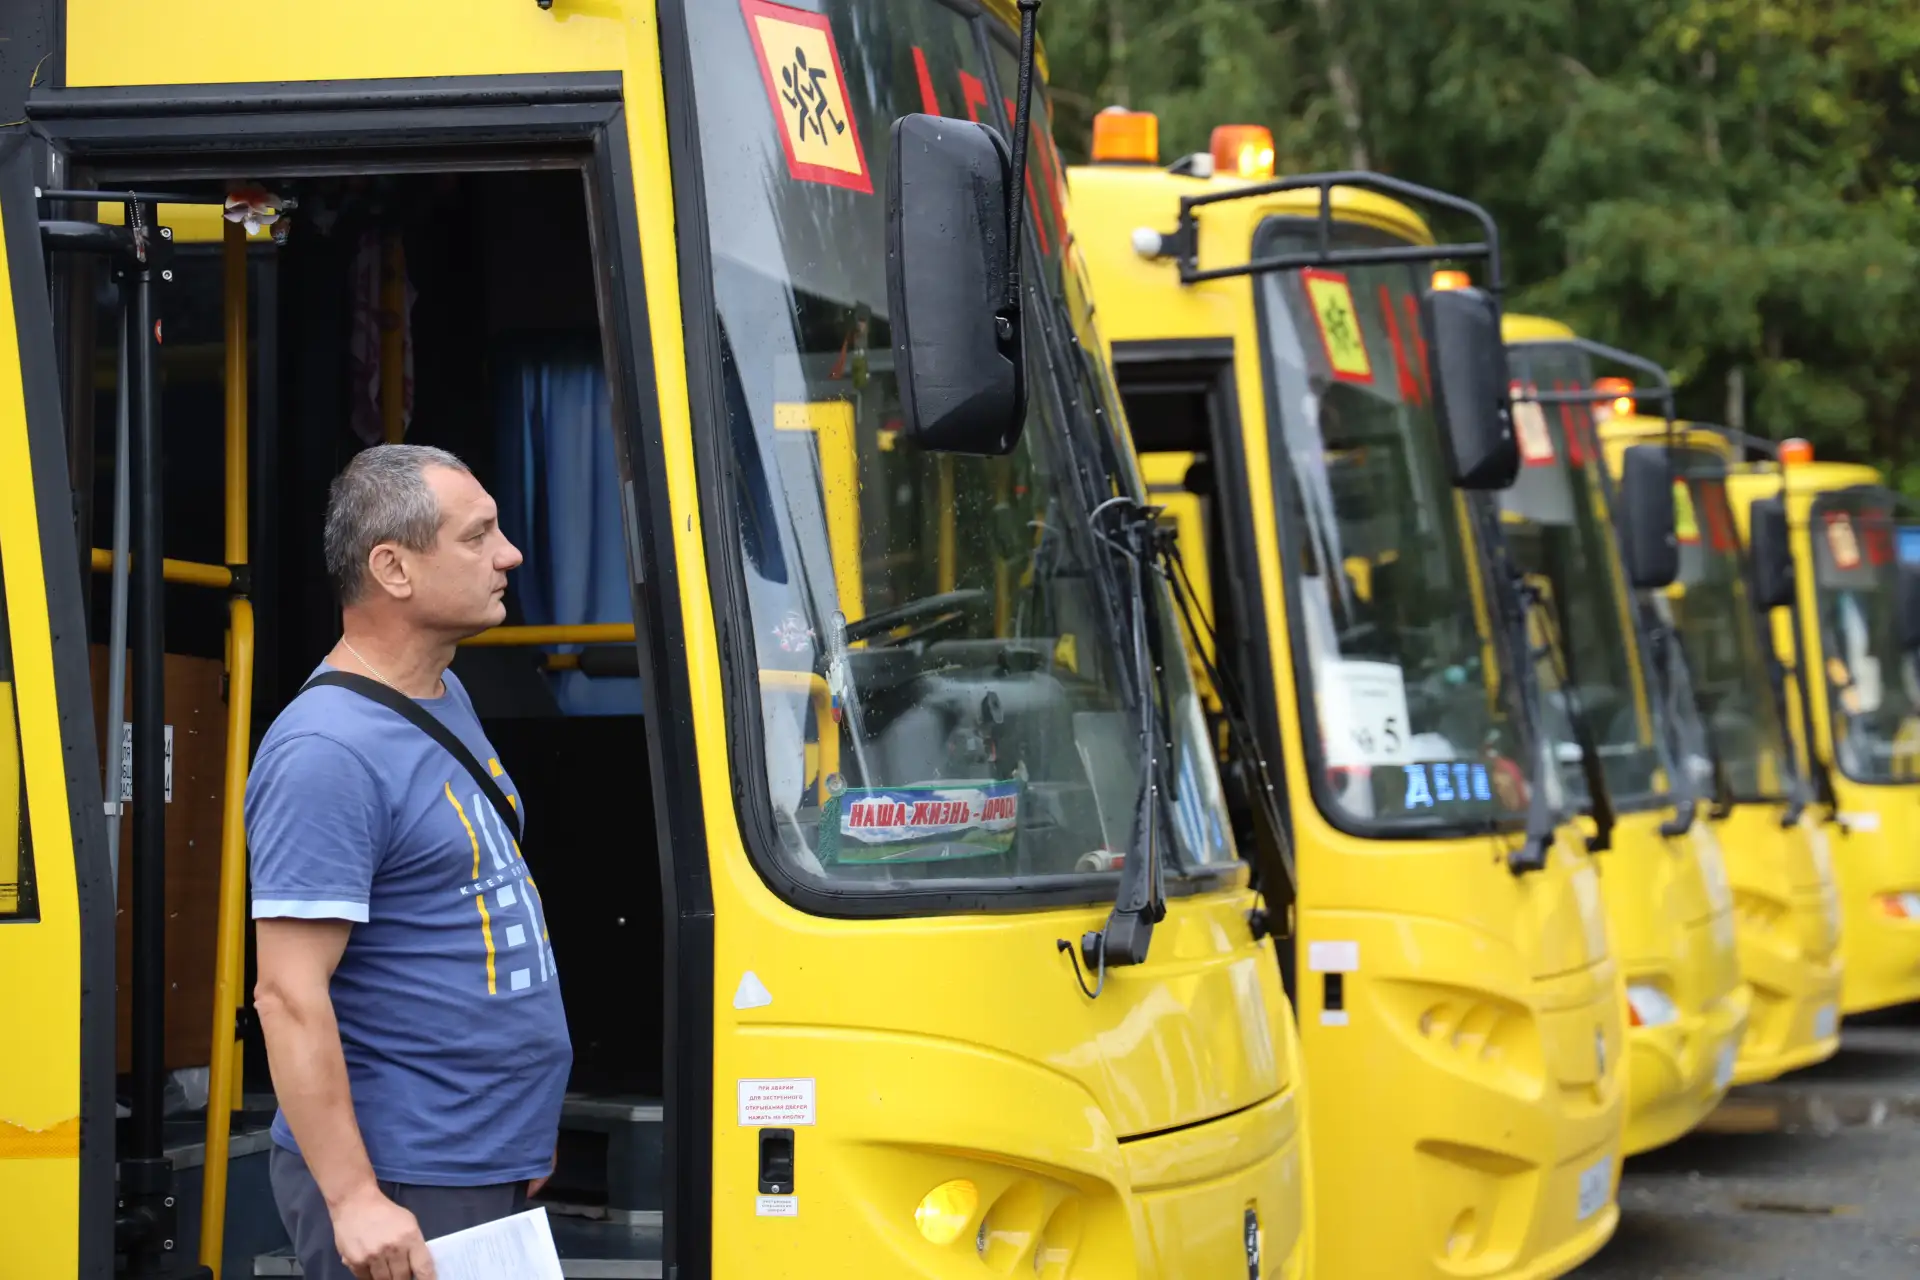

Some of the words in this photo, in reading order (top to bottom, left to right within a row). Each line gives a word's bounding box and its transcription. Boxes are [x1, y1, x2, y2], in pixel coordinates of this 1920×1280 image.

[1383, 716, 1401, 754] 5
[849, 803, 906, 827] НАША
[910, 802, 970, 825] ЖИЗНЬ
[460, 875, 504, 895] KEEP
